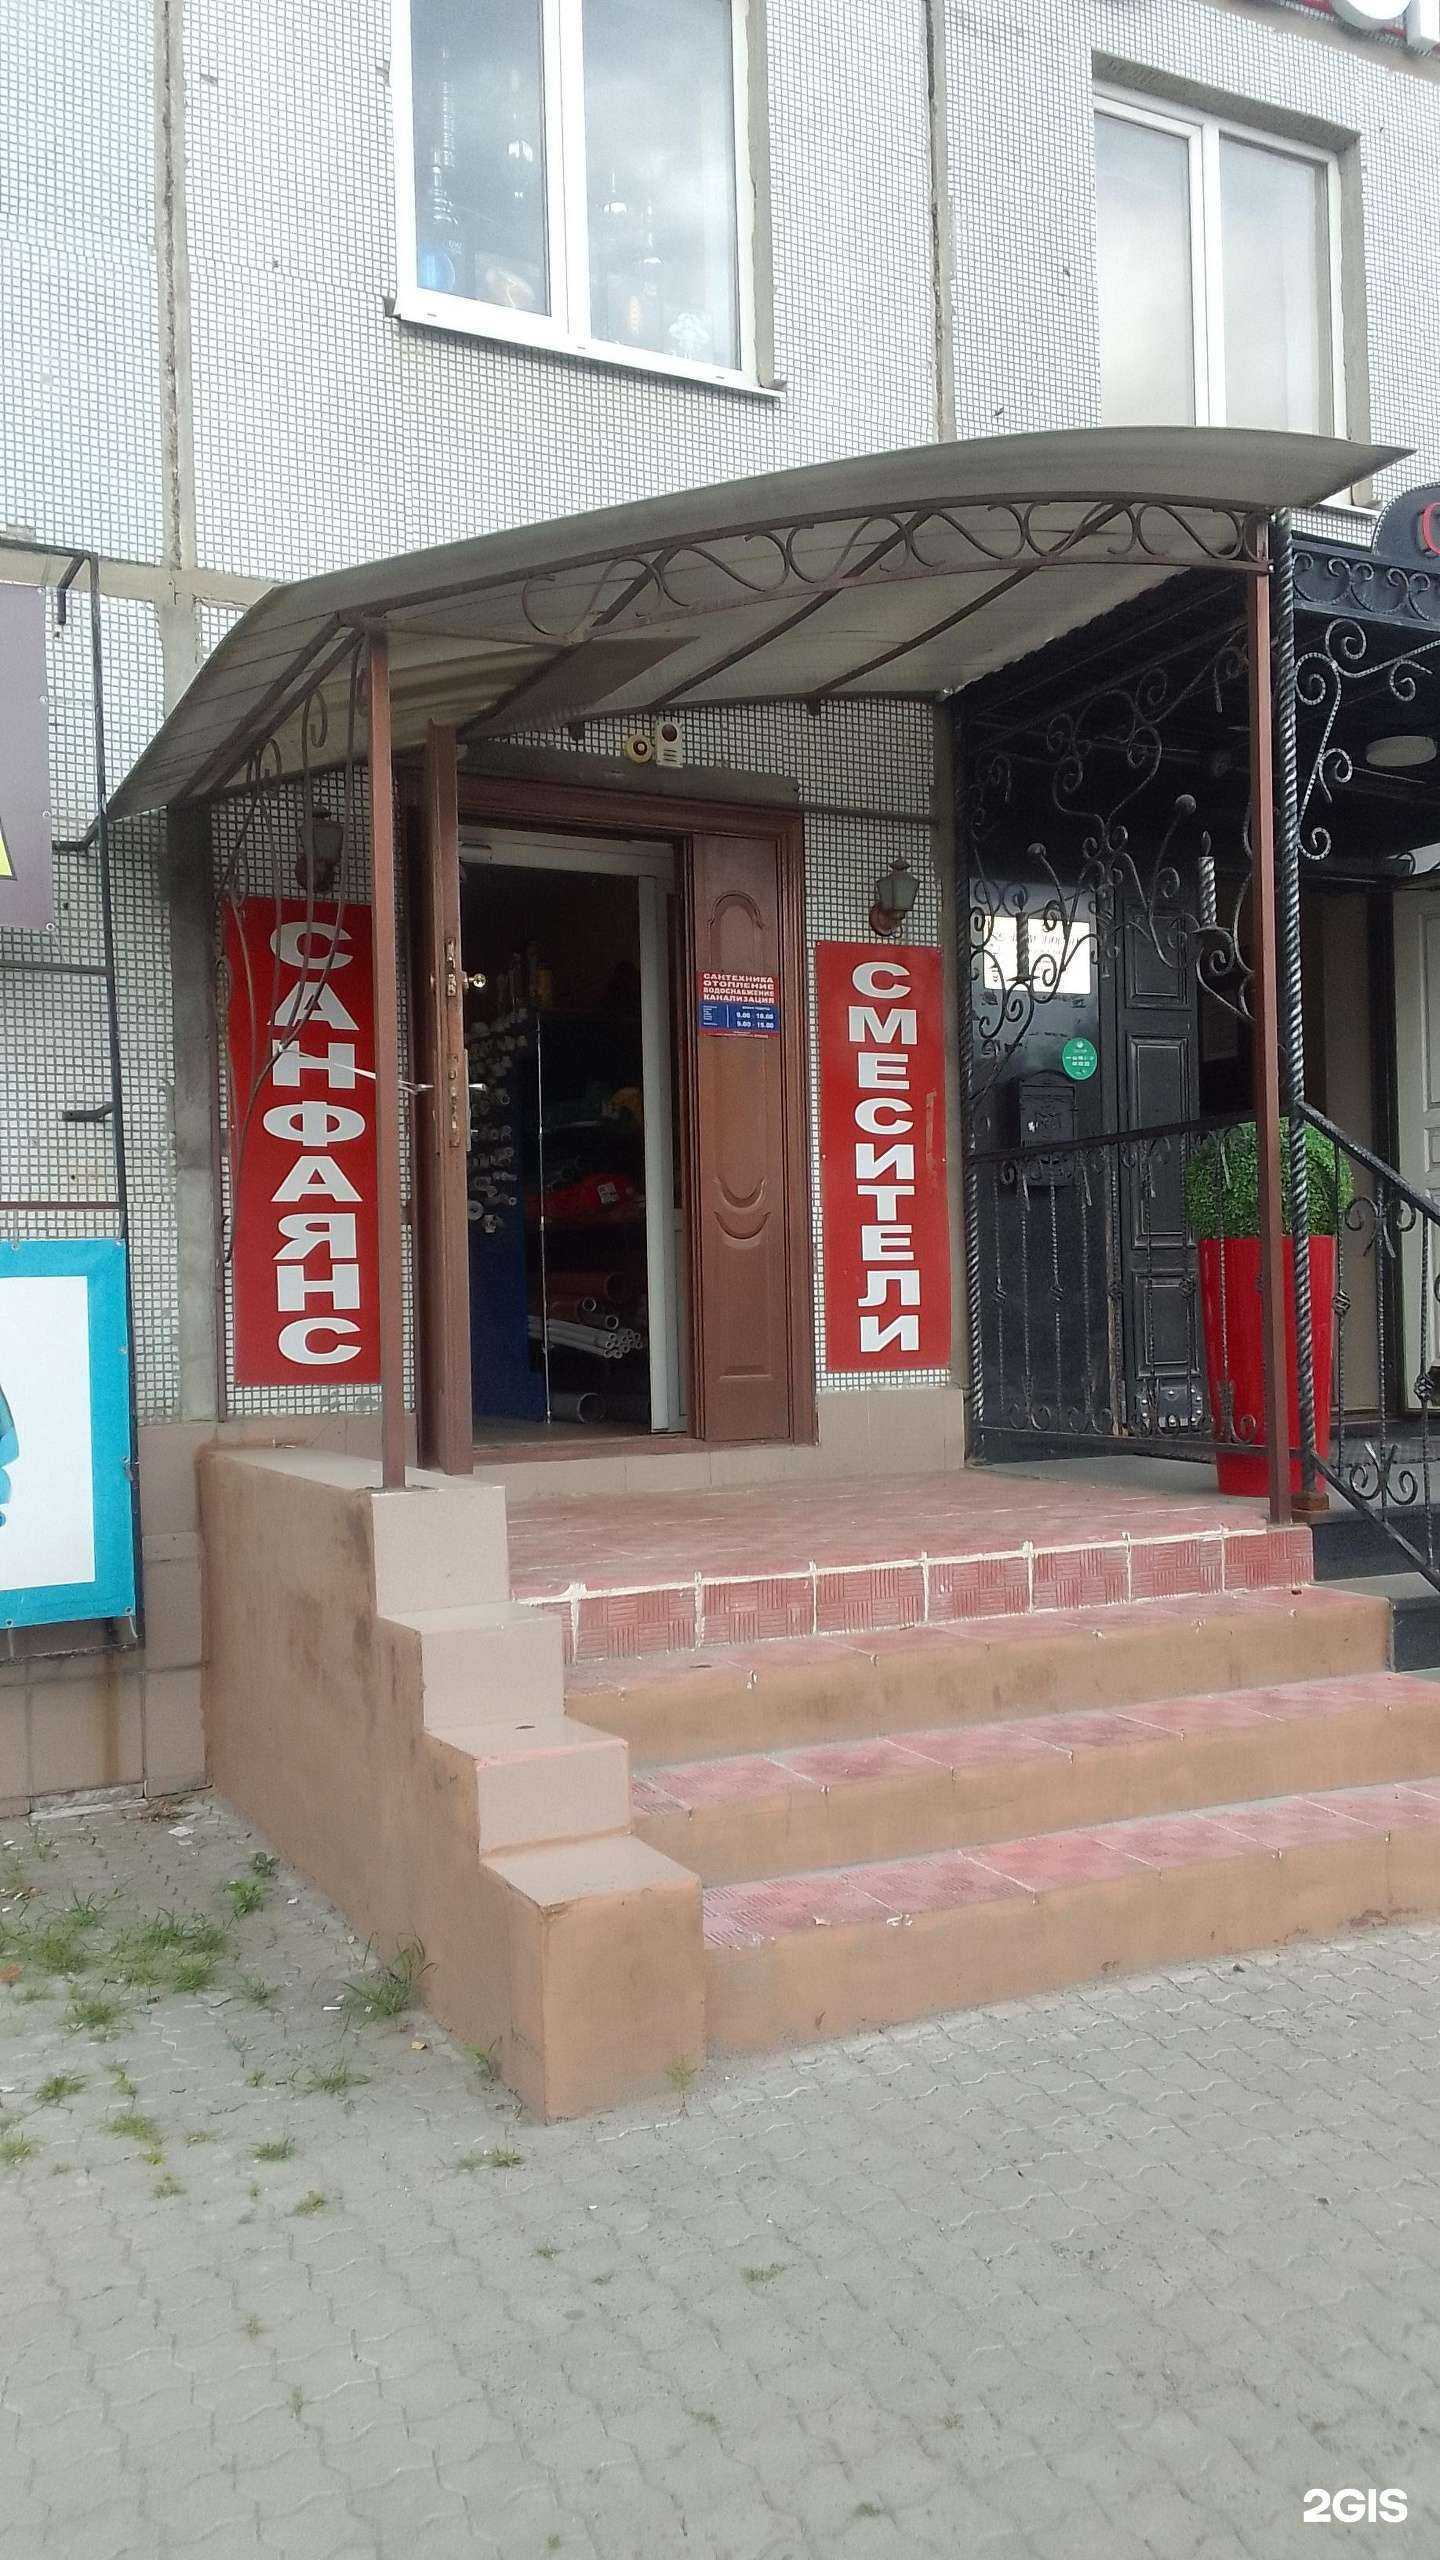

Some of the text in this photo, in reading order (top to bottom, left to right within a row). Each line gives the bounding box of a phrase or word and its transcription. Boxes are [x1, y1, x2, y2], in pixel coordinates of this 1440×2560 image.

[703, 973, 774, 983] САНТЕХНИКА
[703, 980, 774, 990] ОТОПЛЕНИЕ
[703, 987, 774, 997] ВОДОСНАБЖЕНИЕ
[703, 993, 775, 1004] КАНАЛИЗАЦИЯ
[262, 920, 366, 1365] САНФАЯНС
[848, 962, 920, 1352] СМЕСИТЕЛИ
